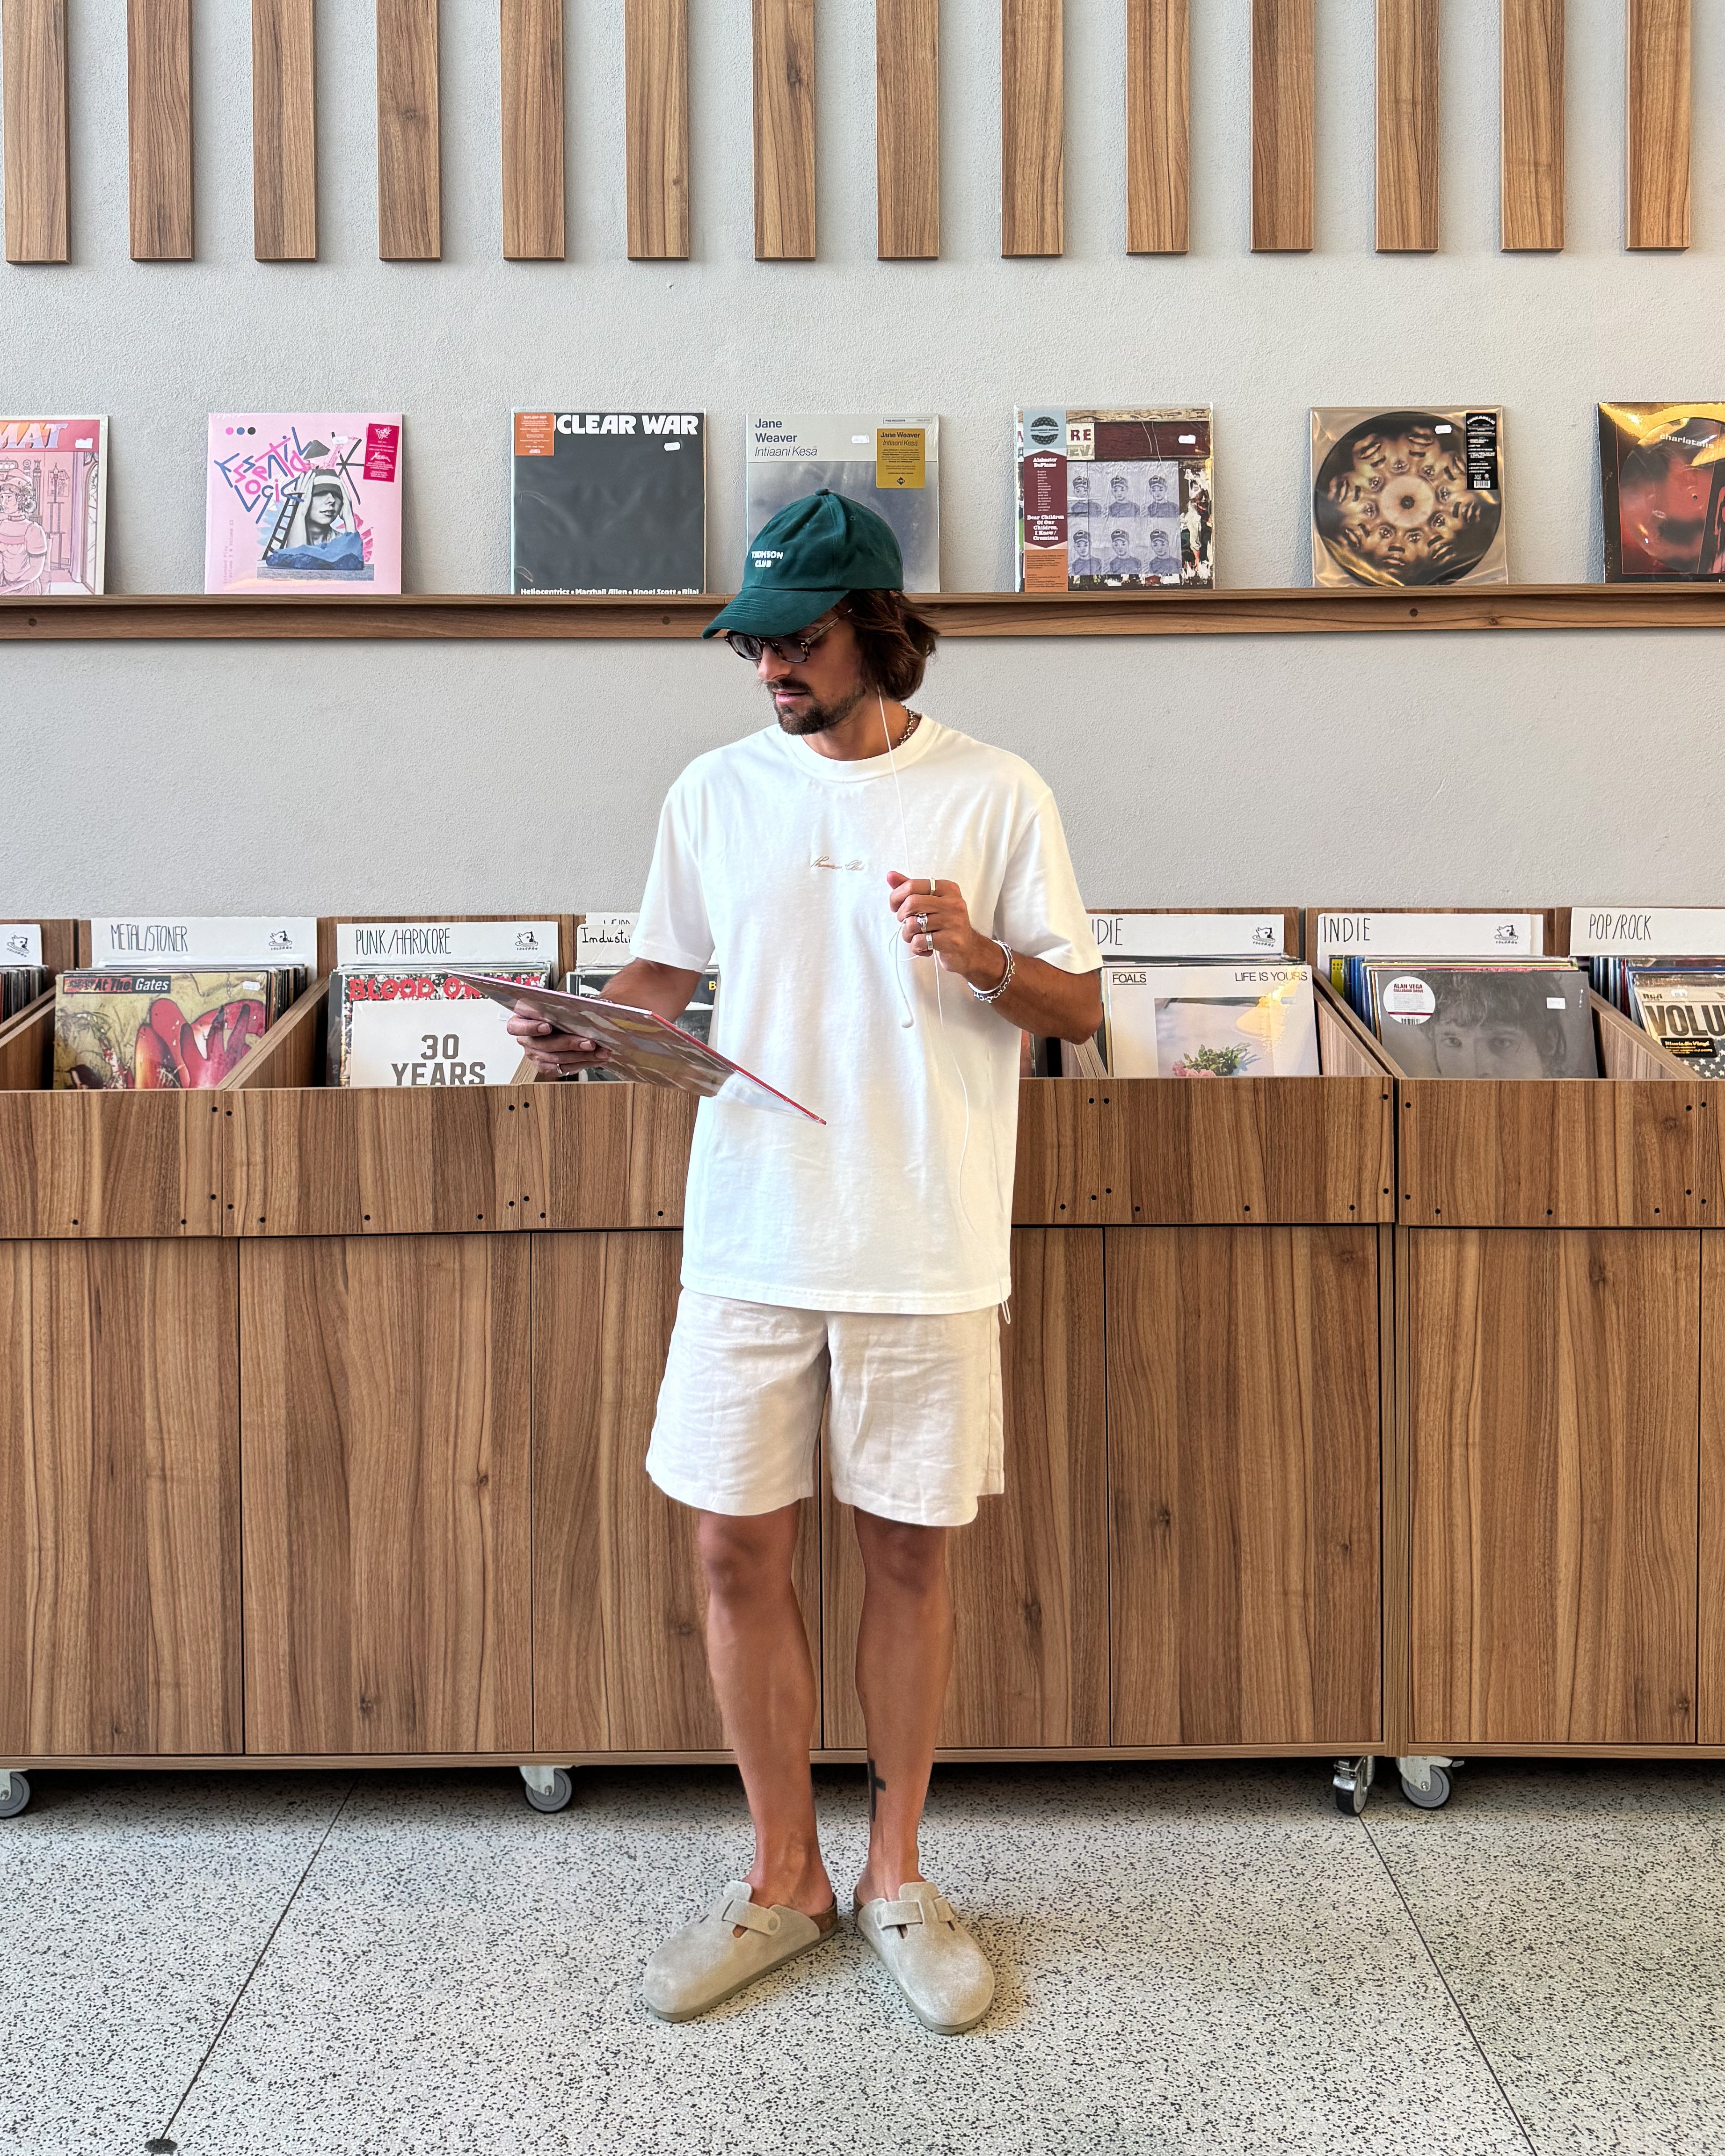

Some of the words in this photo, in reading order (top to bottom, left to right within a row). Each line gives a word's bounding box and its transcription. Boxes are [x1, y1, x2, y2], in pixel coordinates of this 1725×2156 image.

[554, 414, 637, 435] CLEAR
[641, 414, 699, 435] WAR
[755, 418, 783, 428] Jane
[755, 433, 798, 443] Weaver
[755, 446, 791, 457] Intiaani
[792, 446, 818, 457] Kesä
[110, 924, 188, 952] METAL/STONER
[1092, 918, 1123, 946] DIE
[1324, 917, 1371, 943] INDIE
[1589, 914, 1651, 940] POP/ROCK
[356, 928, 451, 955] PUNK/HARDCORE
[94, 978, 109, 991] At
[110, 978, 131, 991] The
[135, 978, 169, 991] Gates
[1112, 973, 1147, 984] FOALS
[1235, 972, 1258, 982] LIFE
[1259, 972, 1268, 981] IS
[1270, 971, 1308, 981] YOURS
[349, 977, 435, 1001] BLOOD
[1645, 1005, 1725, 1036] VOLU
[421, 1033, 459, 1060] 30
[391, 1062, 486, 1085] YEARS
